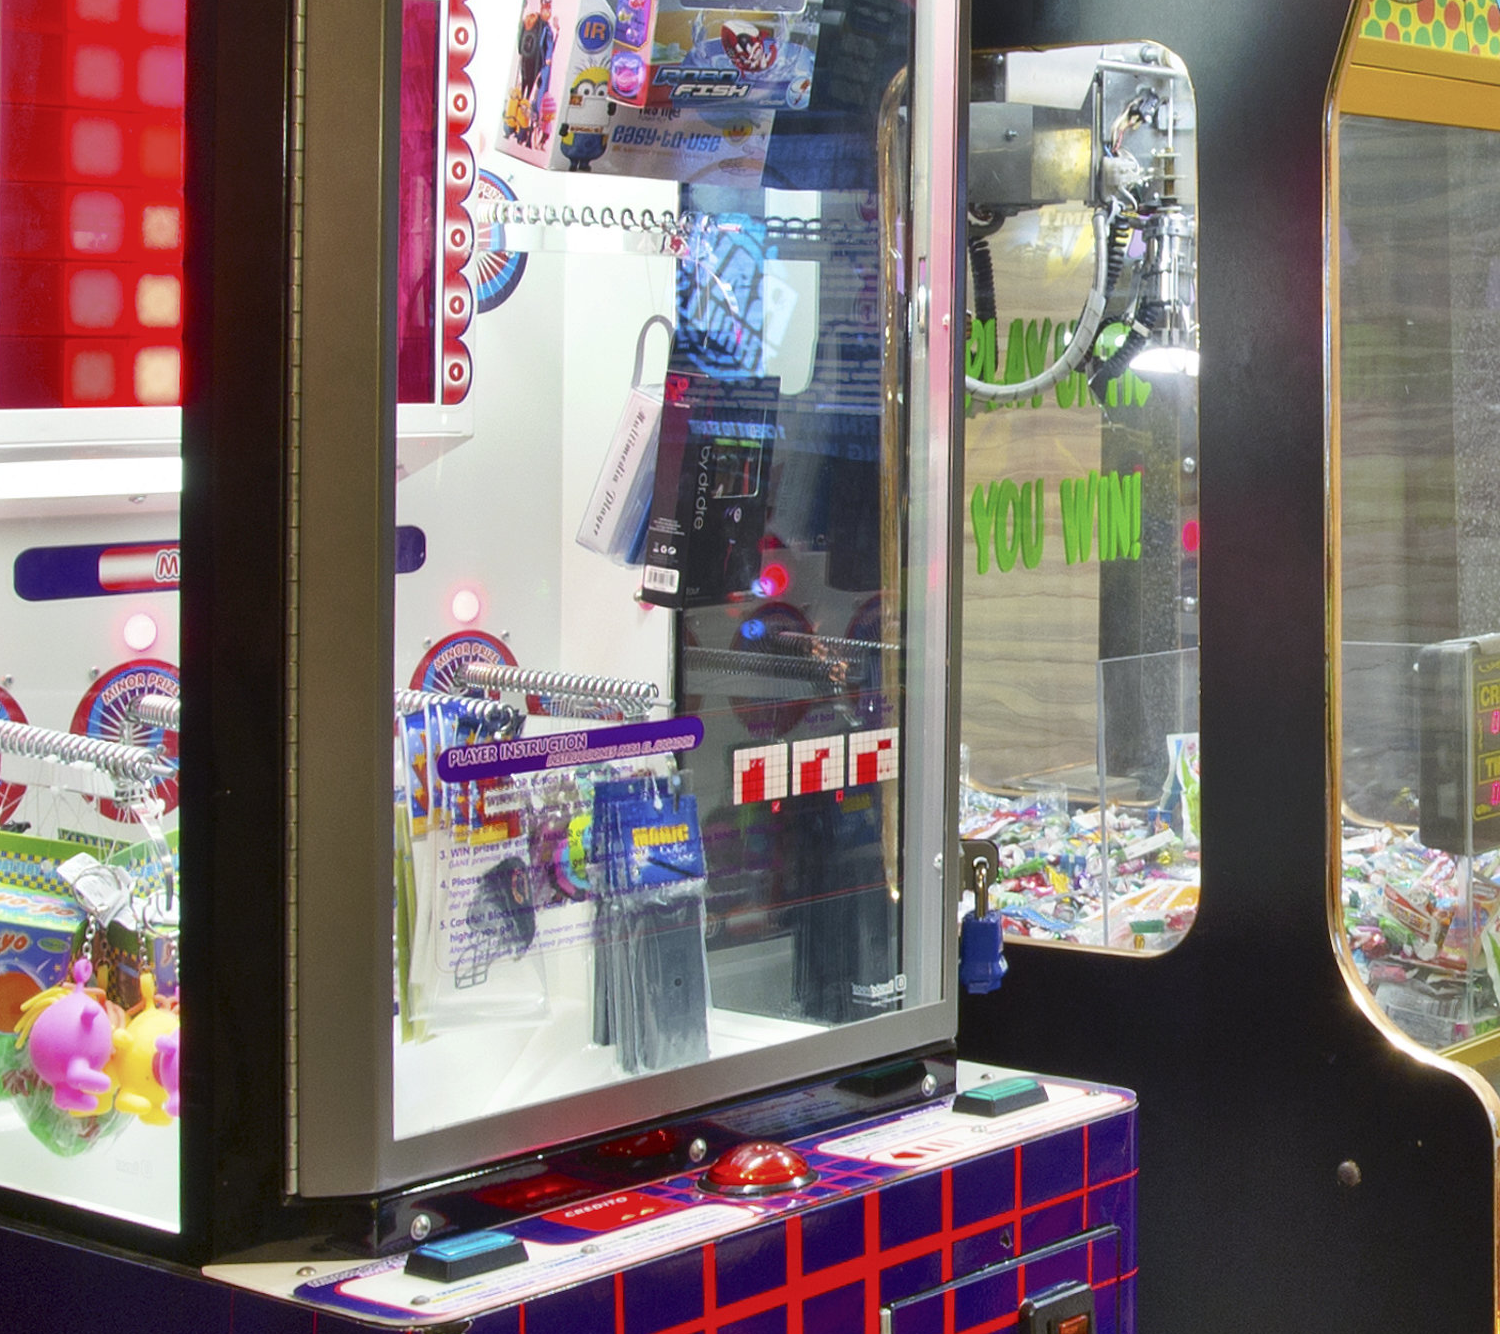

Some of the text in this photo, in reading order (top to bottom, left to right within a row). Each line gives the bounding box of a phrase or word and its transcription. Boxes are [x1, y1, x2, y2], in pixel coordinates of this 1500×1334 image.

[583, 22, 606, 41] IR
[673, 83, 749, 98] FISH
[971, 469, 1142, 575] YOU WIN!
[433, 642, 501, 672] MINOR PRIZE
[102, 671, 180, 706] MINOR PRIZE
[449, 732, 588, 768] PLAYER INSTRUCTION
[564, 1195, 628, 1219] CREDITO
